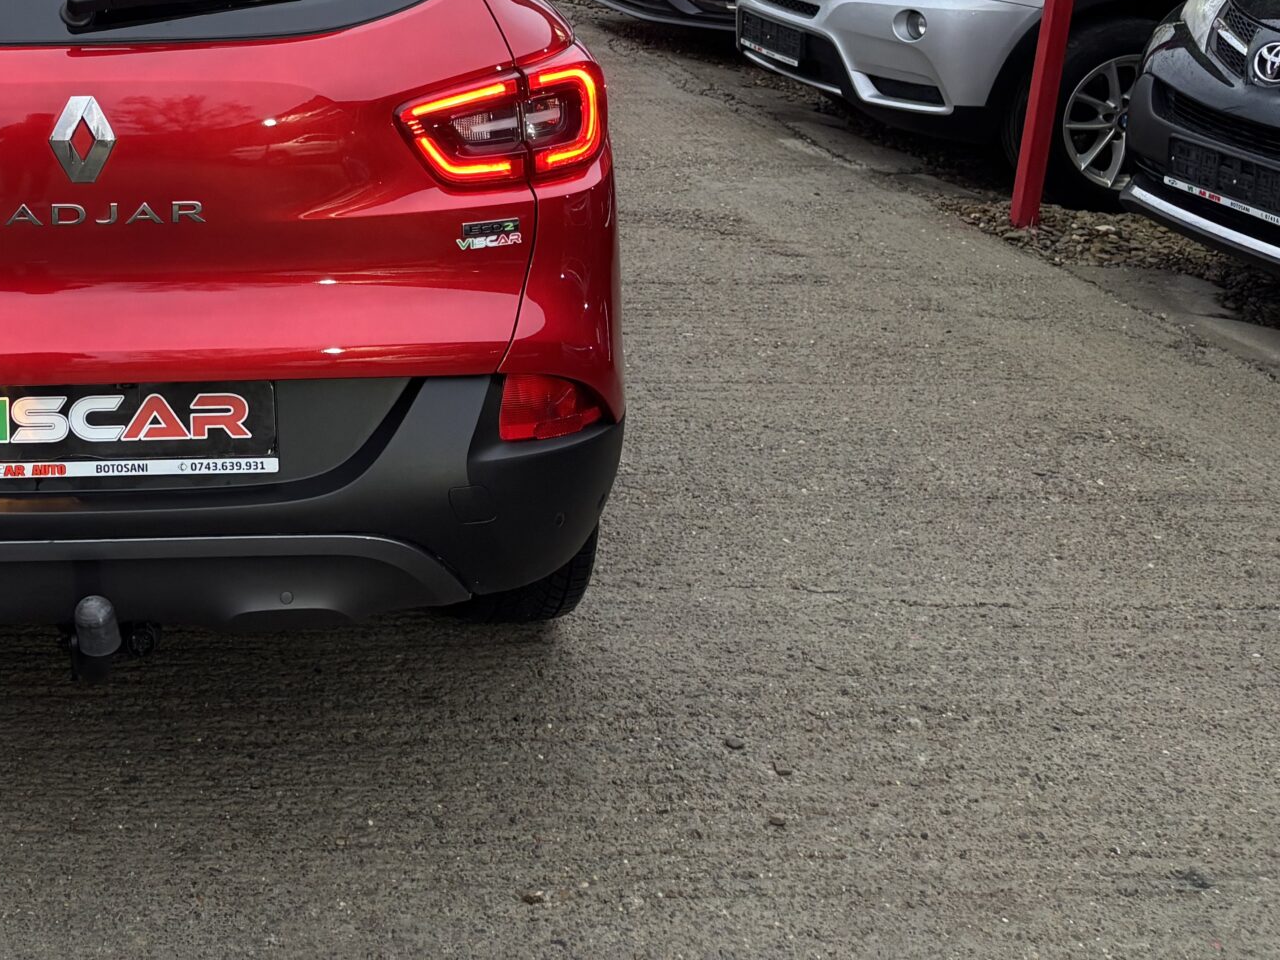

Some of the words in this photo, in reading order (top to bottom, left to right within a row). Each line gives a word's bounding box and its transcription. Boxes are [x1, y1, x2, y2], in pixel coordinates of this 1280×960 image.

[456, 232, 522, 250] VISCAR
[32, 464, 67, 476] AUTO
[95, 463, 149, 474] BOTOSANI
[190, 461, 266, 472] 0743.639.931
